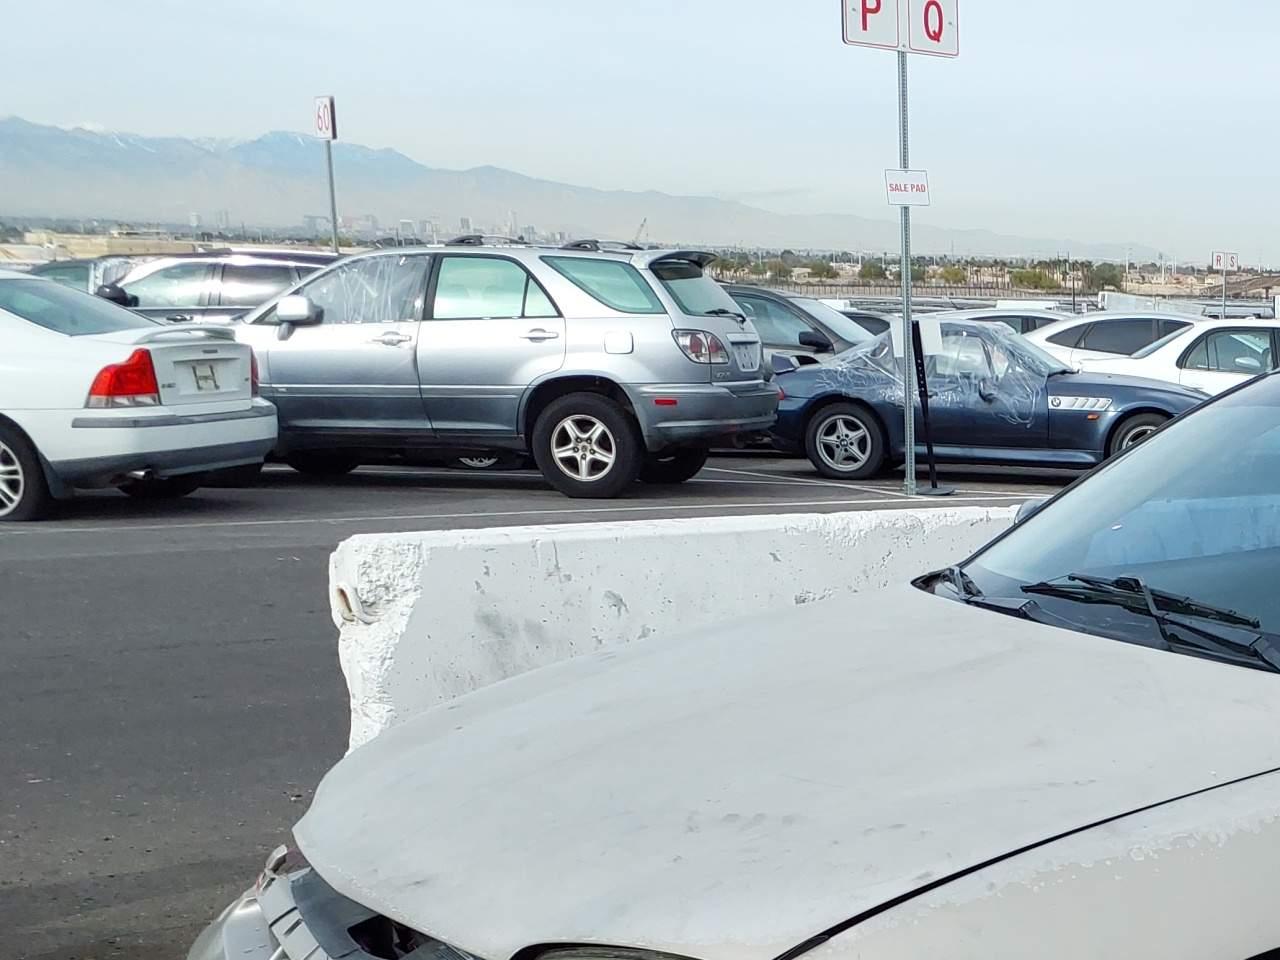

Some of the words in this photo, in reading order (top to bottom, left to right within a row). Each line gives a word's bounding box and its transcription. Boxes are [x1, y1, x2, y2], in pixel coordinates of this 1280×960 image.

[861, 0, 881, 32] P
[923, 0, 944, 43] Q
[317, 103, 330, 132] 60
[889, 183, 909, 193] SALE
[910, 184, 926, 193] PAD
[1216, 255, 1222, 267] R
[1229, 255, 1235, 268] S
